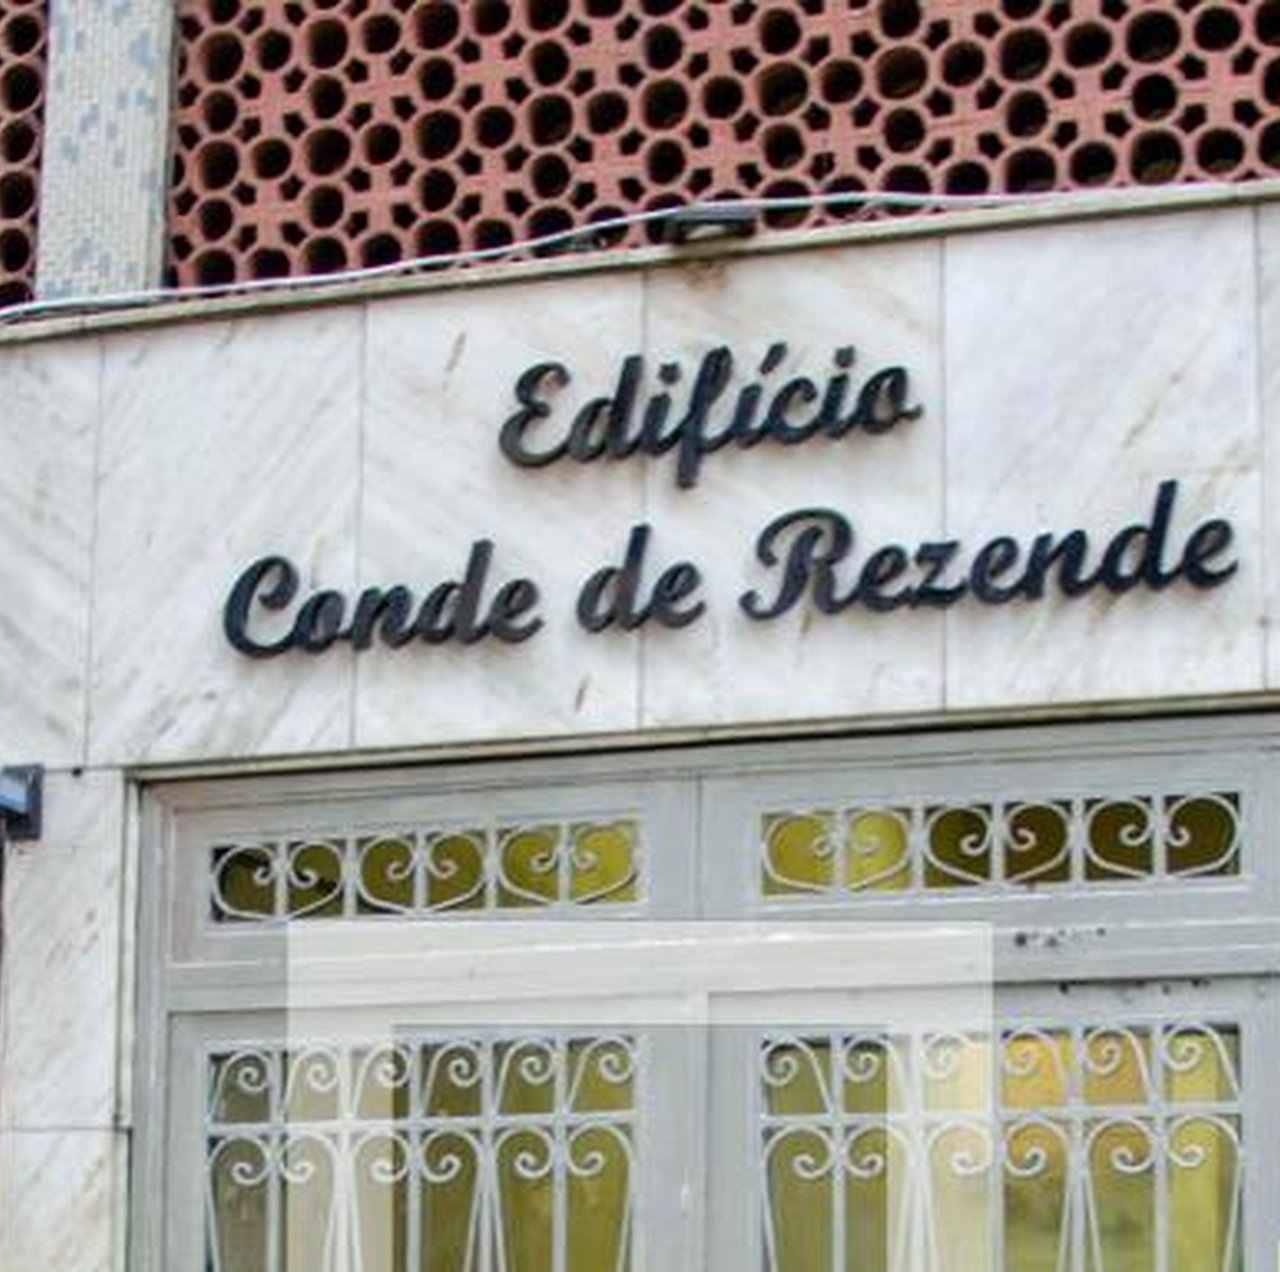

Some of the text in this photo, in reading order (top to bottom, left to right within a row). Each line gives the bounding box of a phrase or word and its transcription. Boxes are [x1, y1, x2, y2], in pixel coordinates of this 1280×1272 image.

[498, 343, 924, 489] Edifício
[224, 480, 1238, 659] Conde de Rezende
